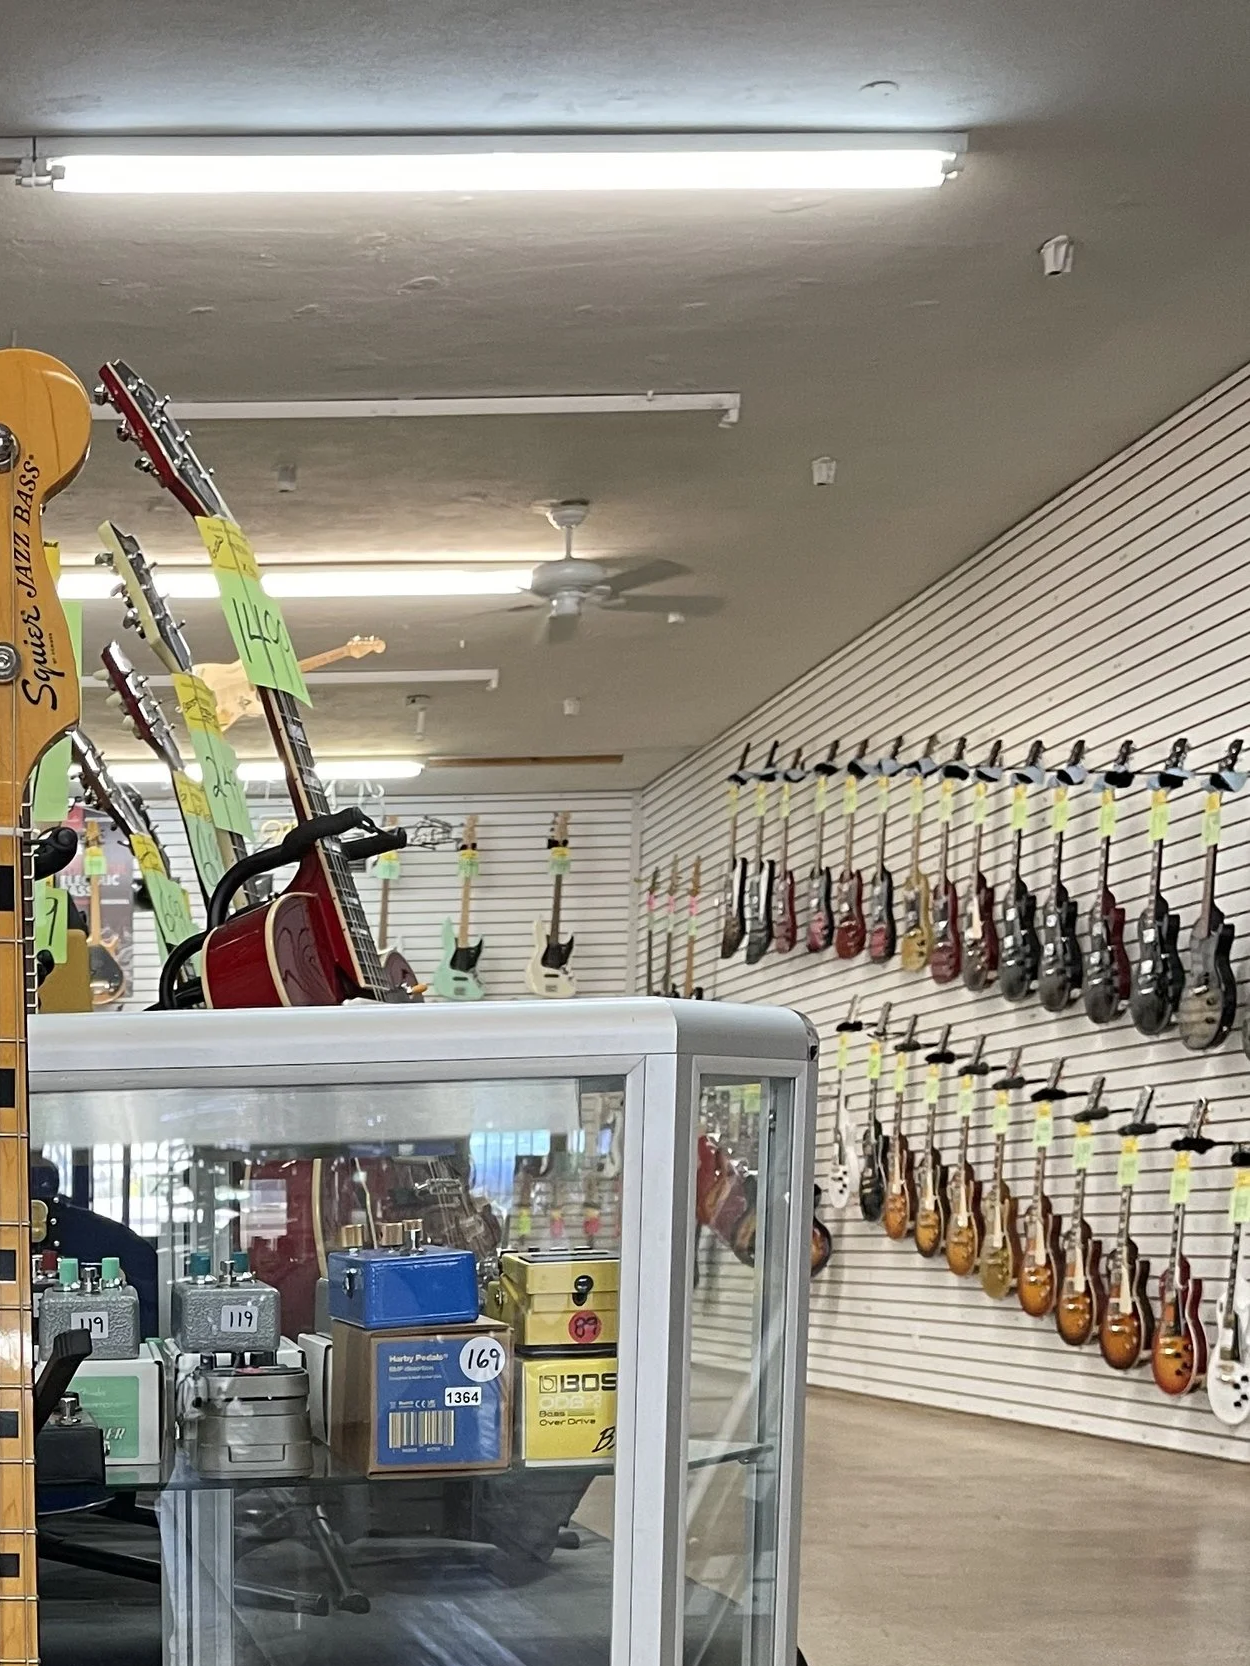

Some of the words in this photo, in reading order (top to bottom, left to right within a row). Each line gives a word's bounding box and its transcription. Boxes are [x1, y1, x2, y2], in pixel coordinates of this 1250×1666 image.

[14, 459, 40, 528] BASS
[14, 531, 37, 598] JAZZ
[21, 605, 66, 711] Squier
[60, 873, 121, 886] ELECRIC
[79, 1316, 104, 1333] 119
[228, 1309, 254, 1328] 119
[574, 1316, 598, 1338] 89
[467, 1347, 501, 1371] 169
[560, 1373, 617, 1393] BOS
[446, 1391, 479, 1404] 1364
[538, 1410, 566, 1418] Bass
[539, 1418, 566, 1426] Over
[567, 1417, 597, 1426] Drive
